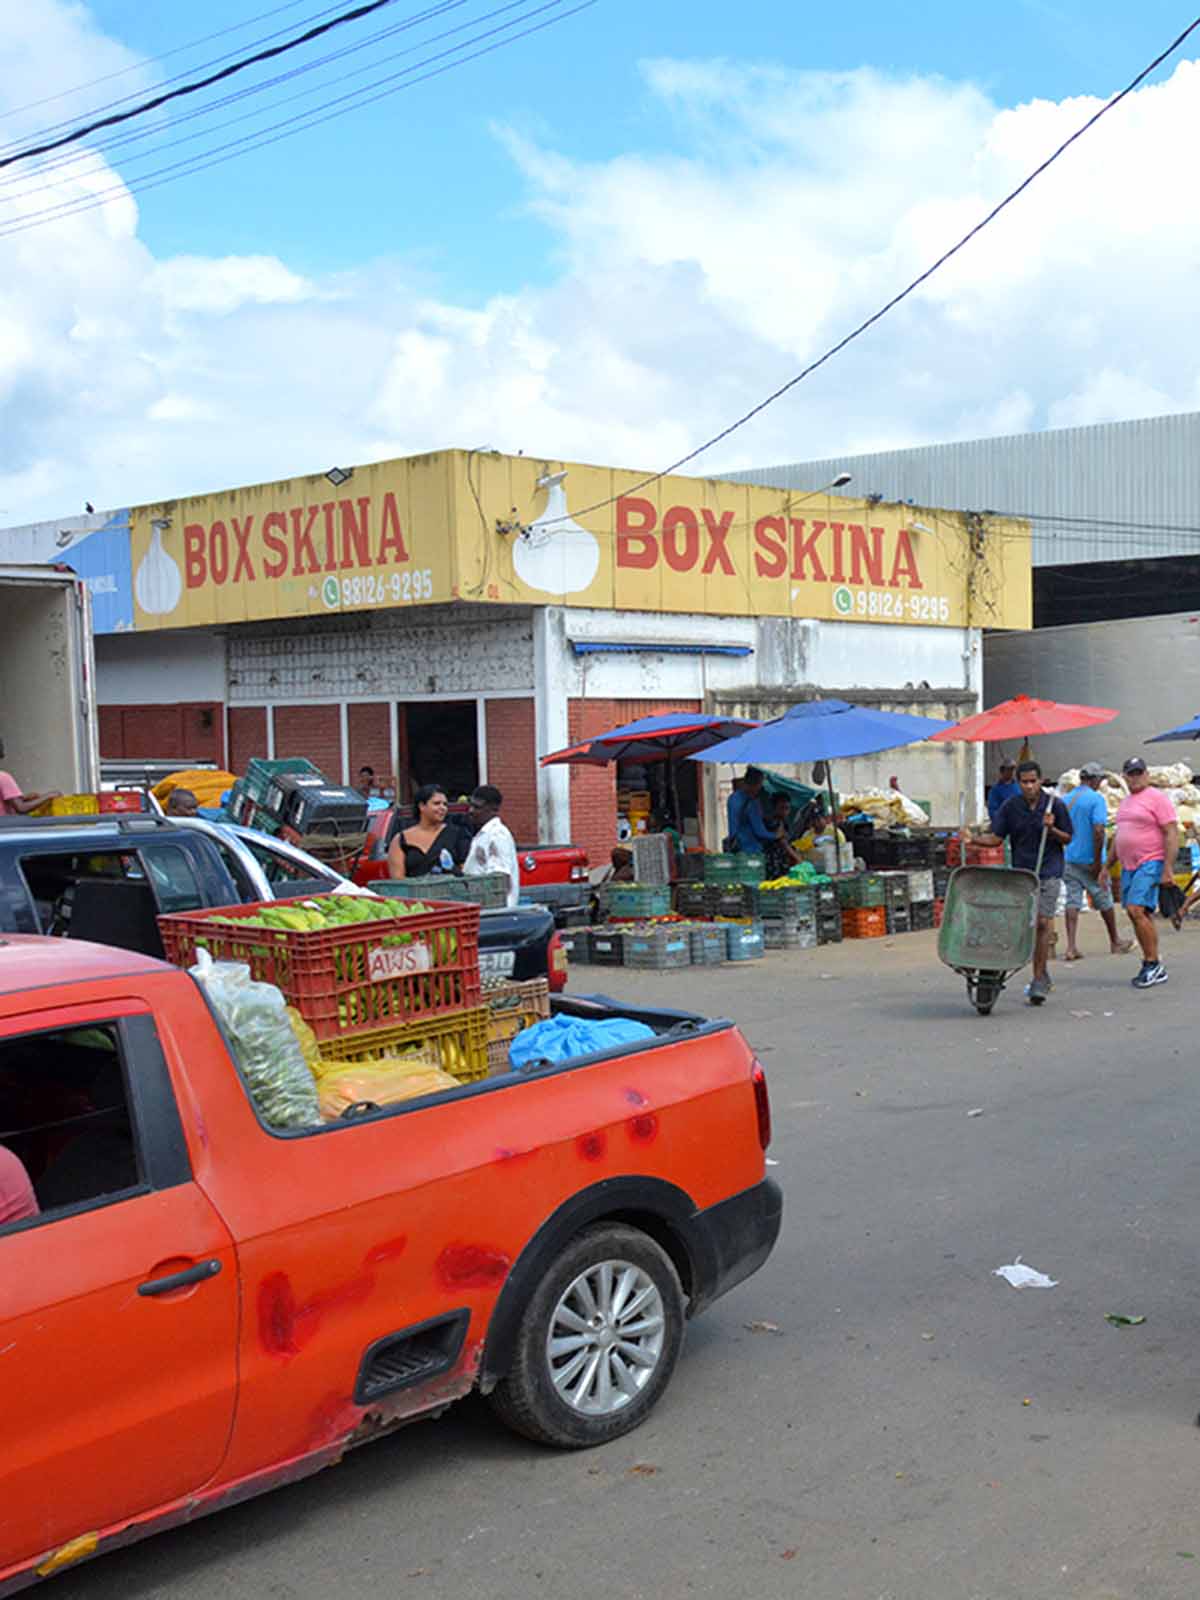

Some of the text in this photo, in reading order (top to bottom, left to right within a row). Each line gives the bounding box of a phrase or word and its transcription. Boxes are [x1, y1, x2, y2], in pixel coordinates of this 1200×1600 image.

[184, 492, 409, 589] BOX SKINA
[616, 495, 923, 589] BOX SKINA
[341, 570, 433, 605] 98126-9295
[856, 591, 949, 621] 98126-9295
